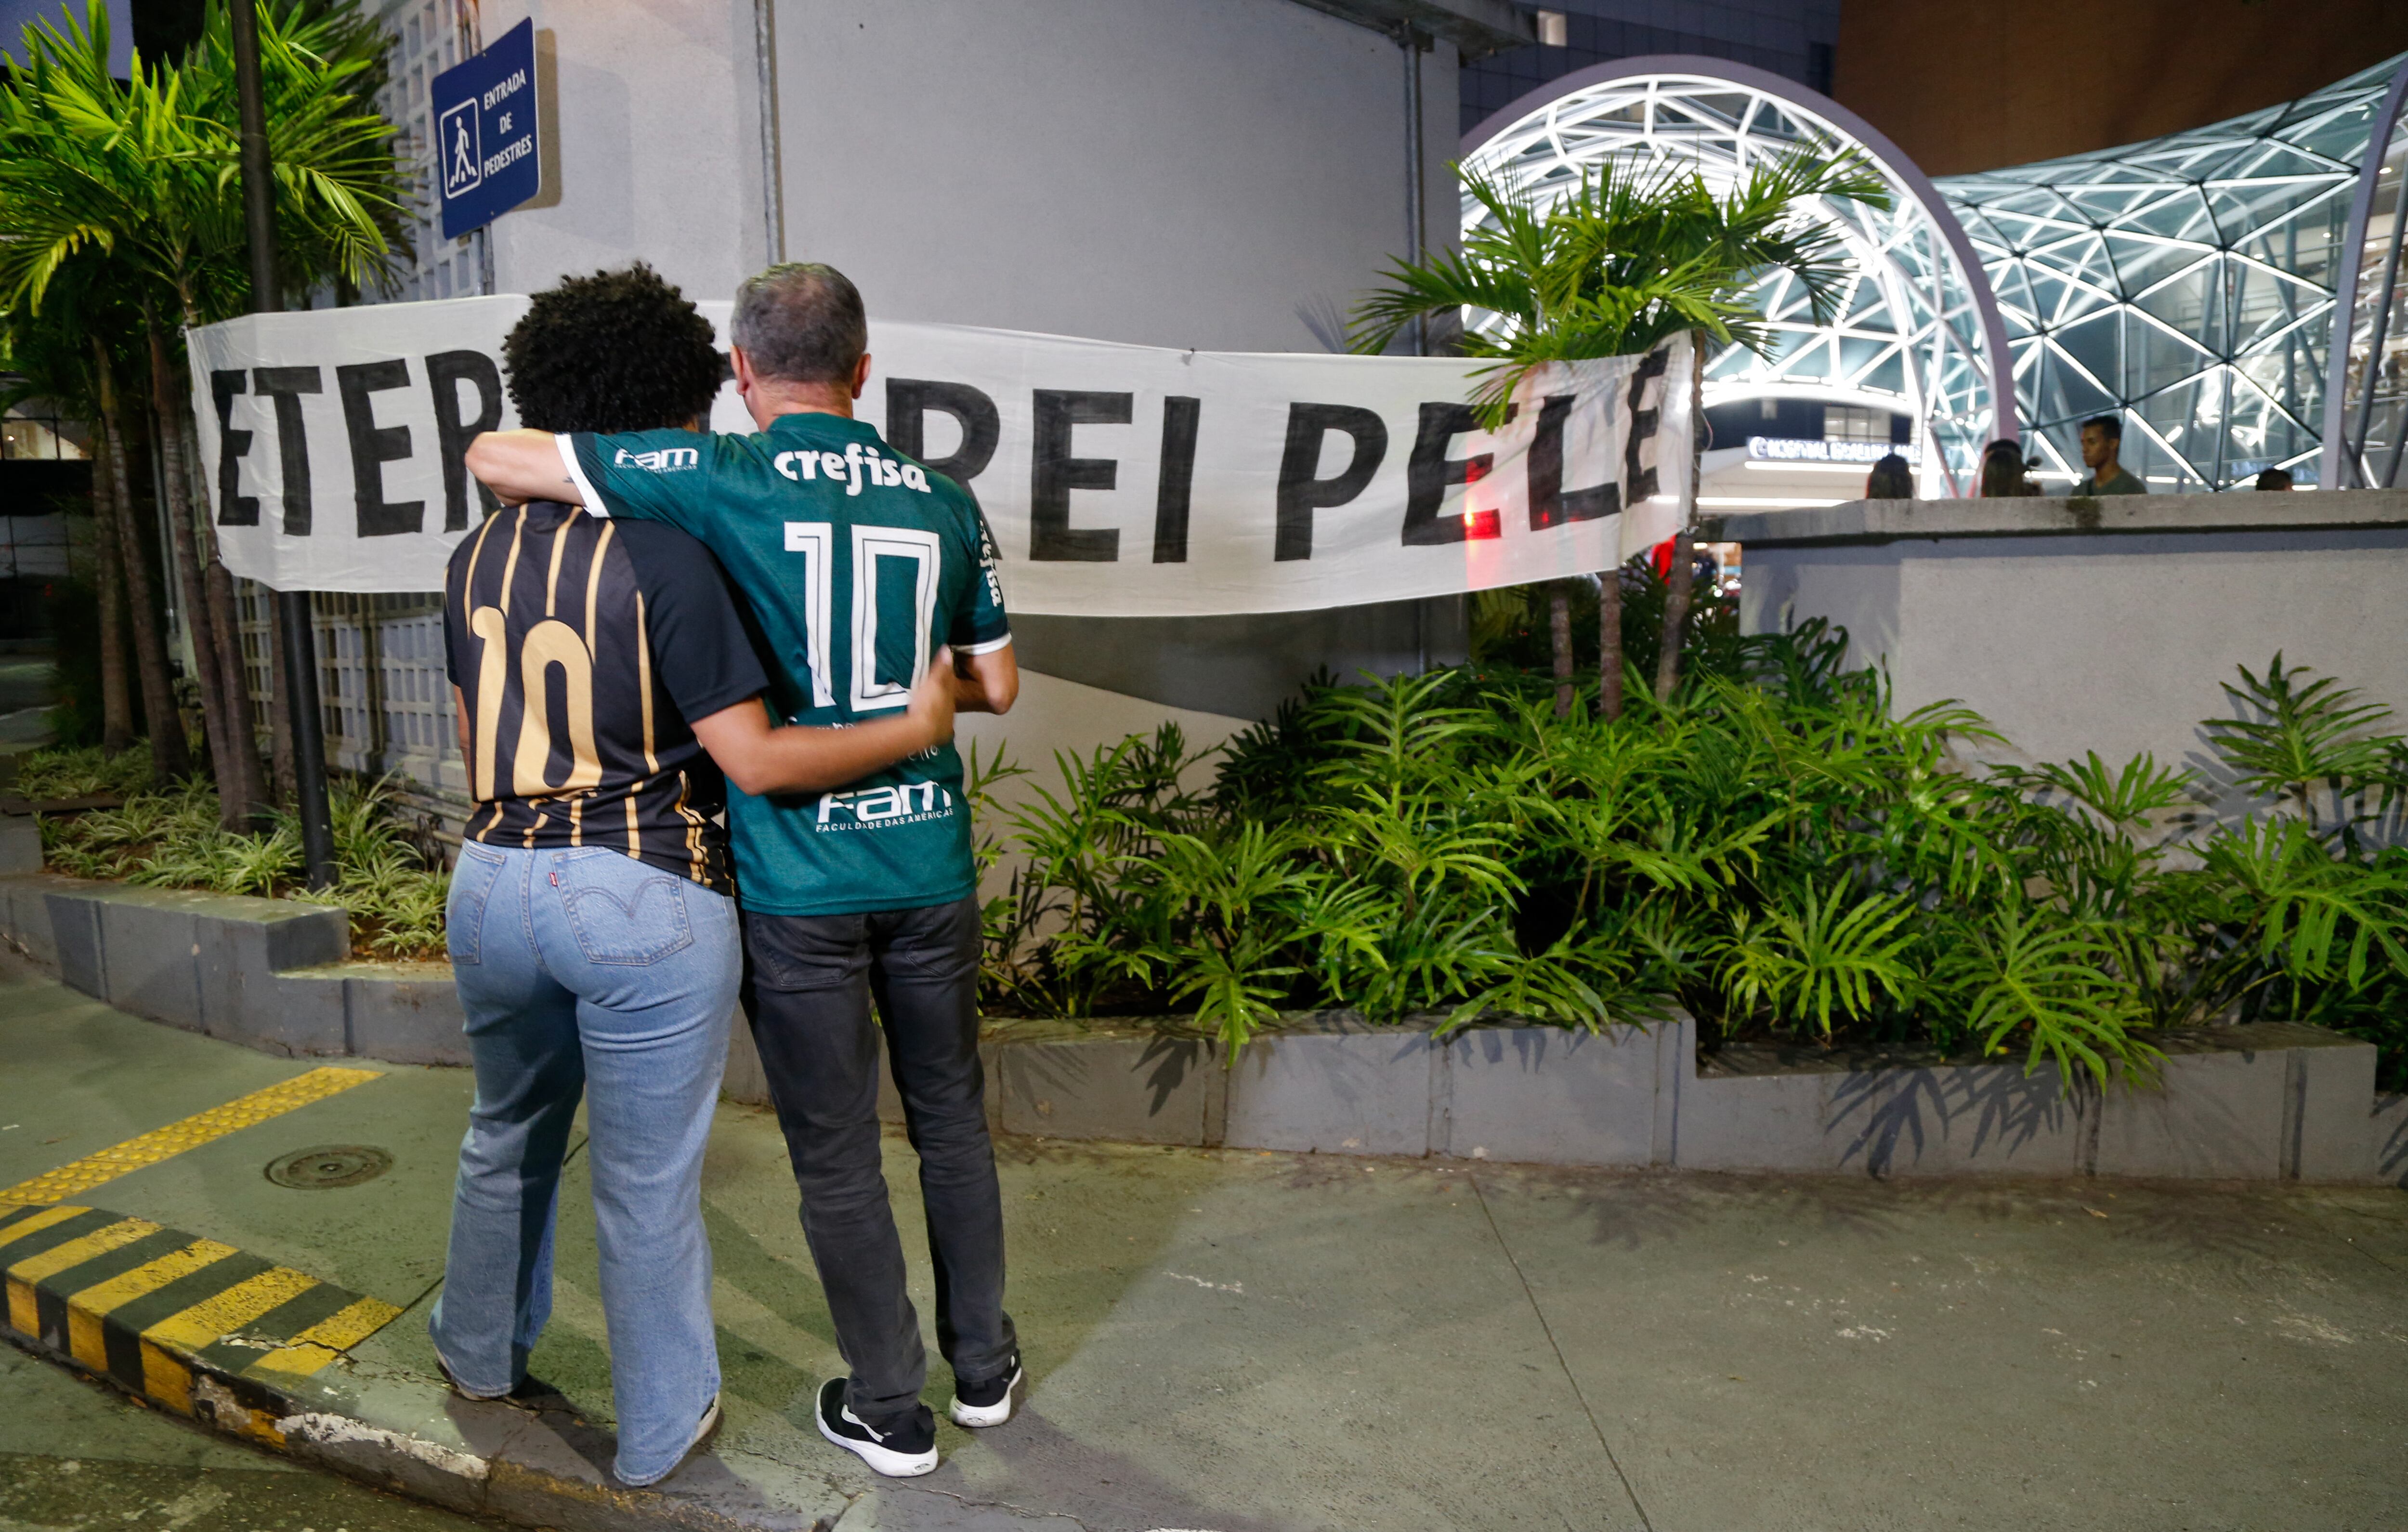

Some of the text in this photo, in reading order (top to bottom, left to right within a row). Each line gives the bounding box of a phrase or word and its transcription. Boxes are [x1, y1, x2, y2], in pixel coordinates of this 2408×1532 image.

[484, 68, 526, 111] ENTRADA
[499, 111, 513, 134] DE
[484, 134, 533, 178] PEDESTRES
[774, 442, 932, 497] crefisa
[886, 377, 1201, 563] REI
[784, 521, 941, 713] 10
[471, 605, 602, 801] 10
[884, 816, 905, 827] DAS
